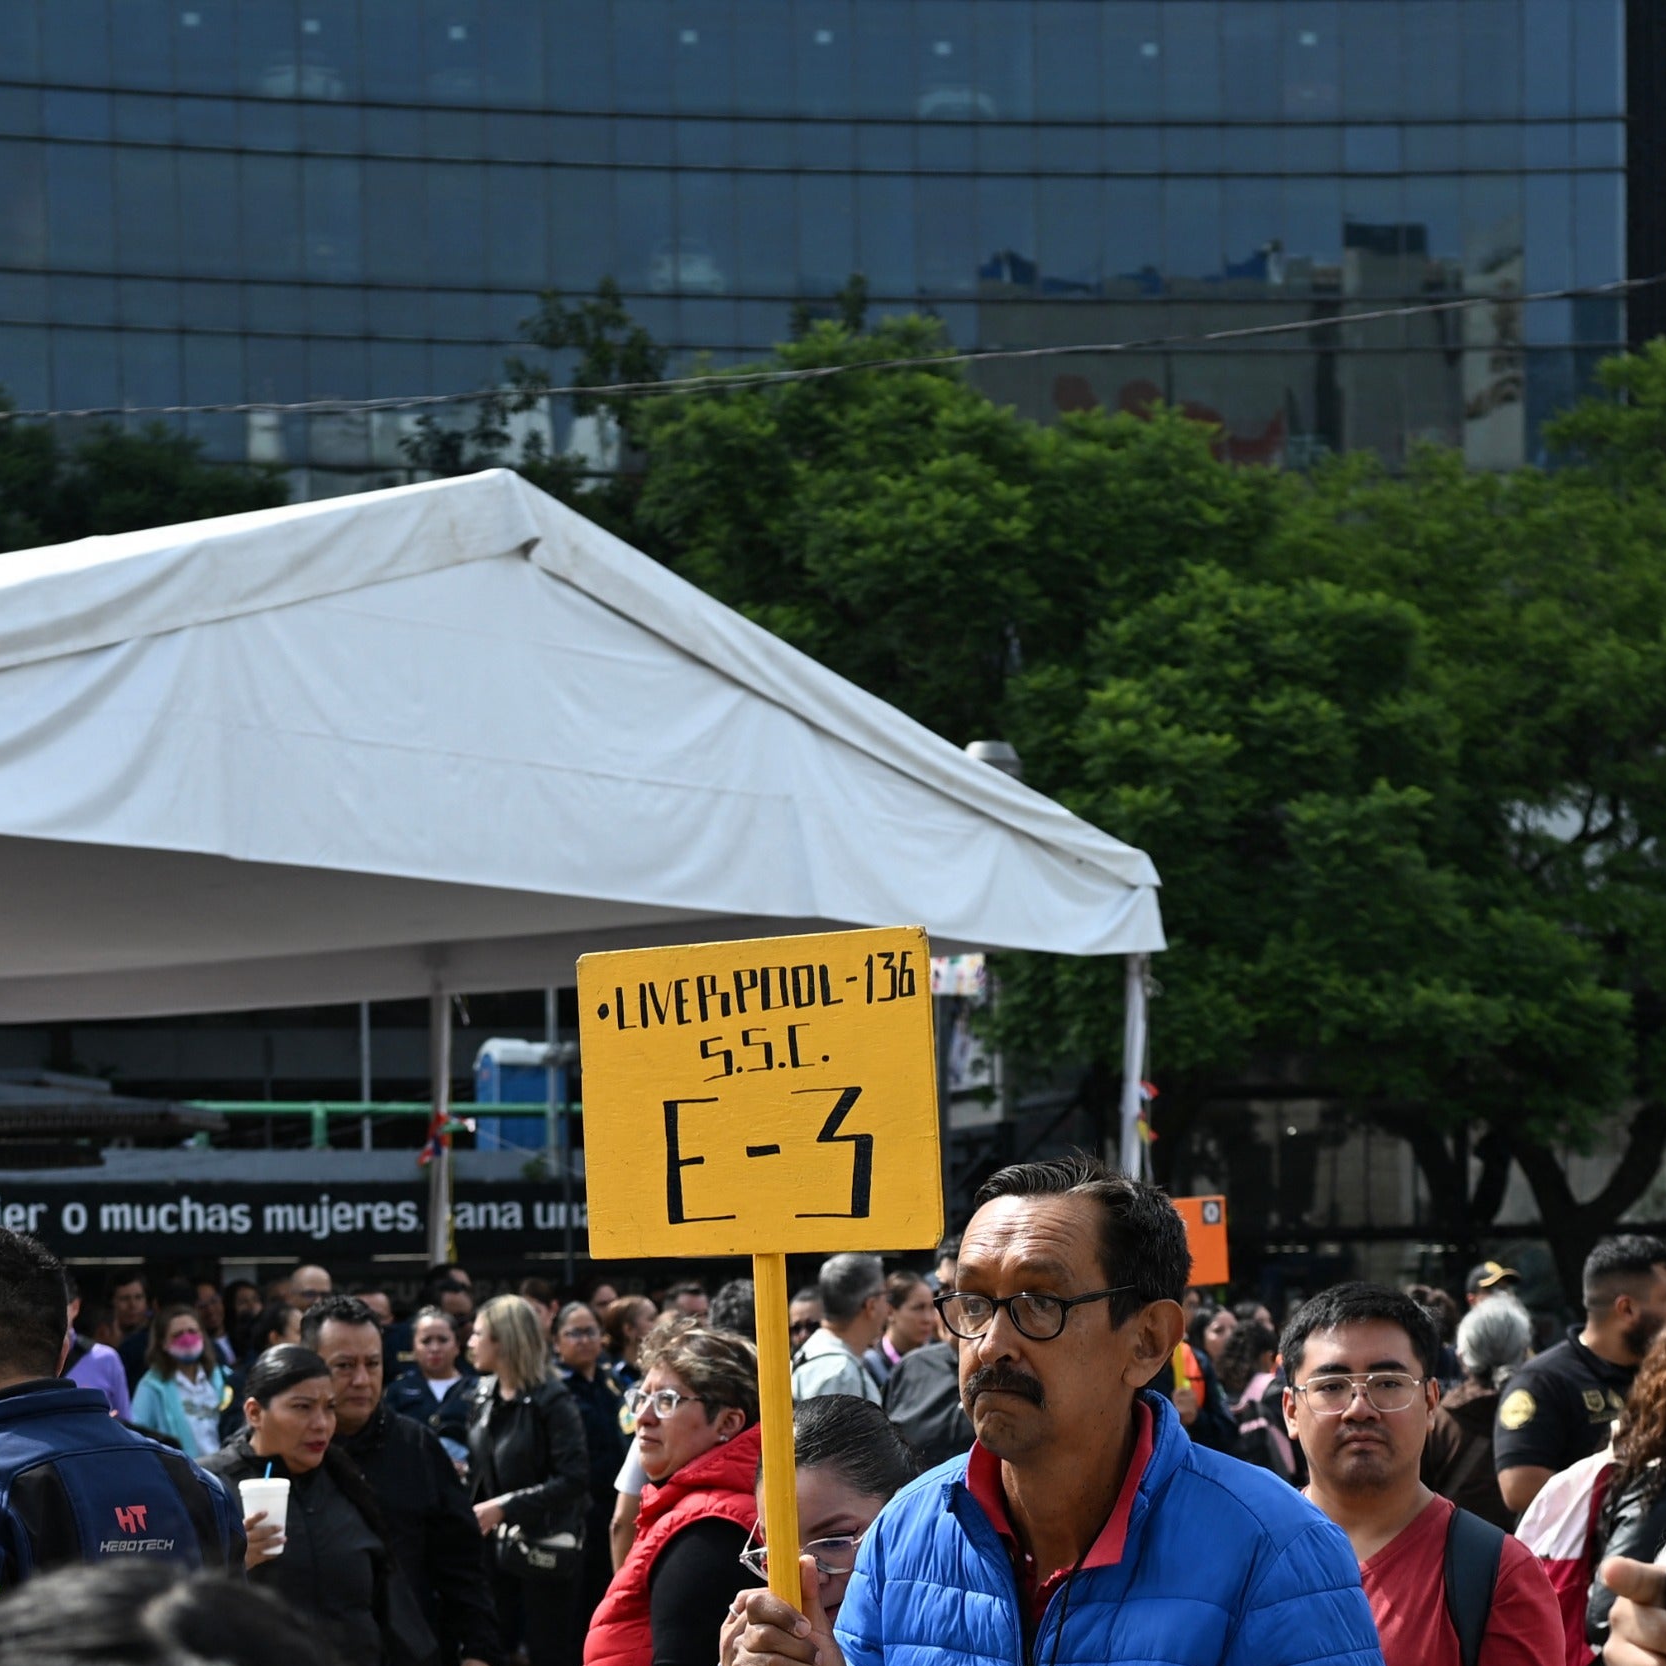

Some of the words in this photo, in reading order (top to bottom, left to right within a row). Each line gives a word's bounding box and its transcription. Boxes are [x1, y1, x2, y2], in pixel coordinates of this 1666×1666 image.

[700, 1023, 830, 1082] S.S.C.
[62, 1202, 87, 1234] o
[100, 1196, 252, 1233] muchas
[454, 1202, 524, 1231] ana
[115, 1505, 147, 1533] HT
[100, 1539, 174, 1552] HEBOTECH
